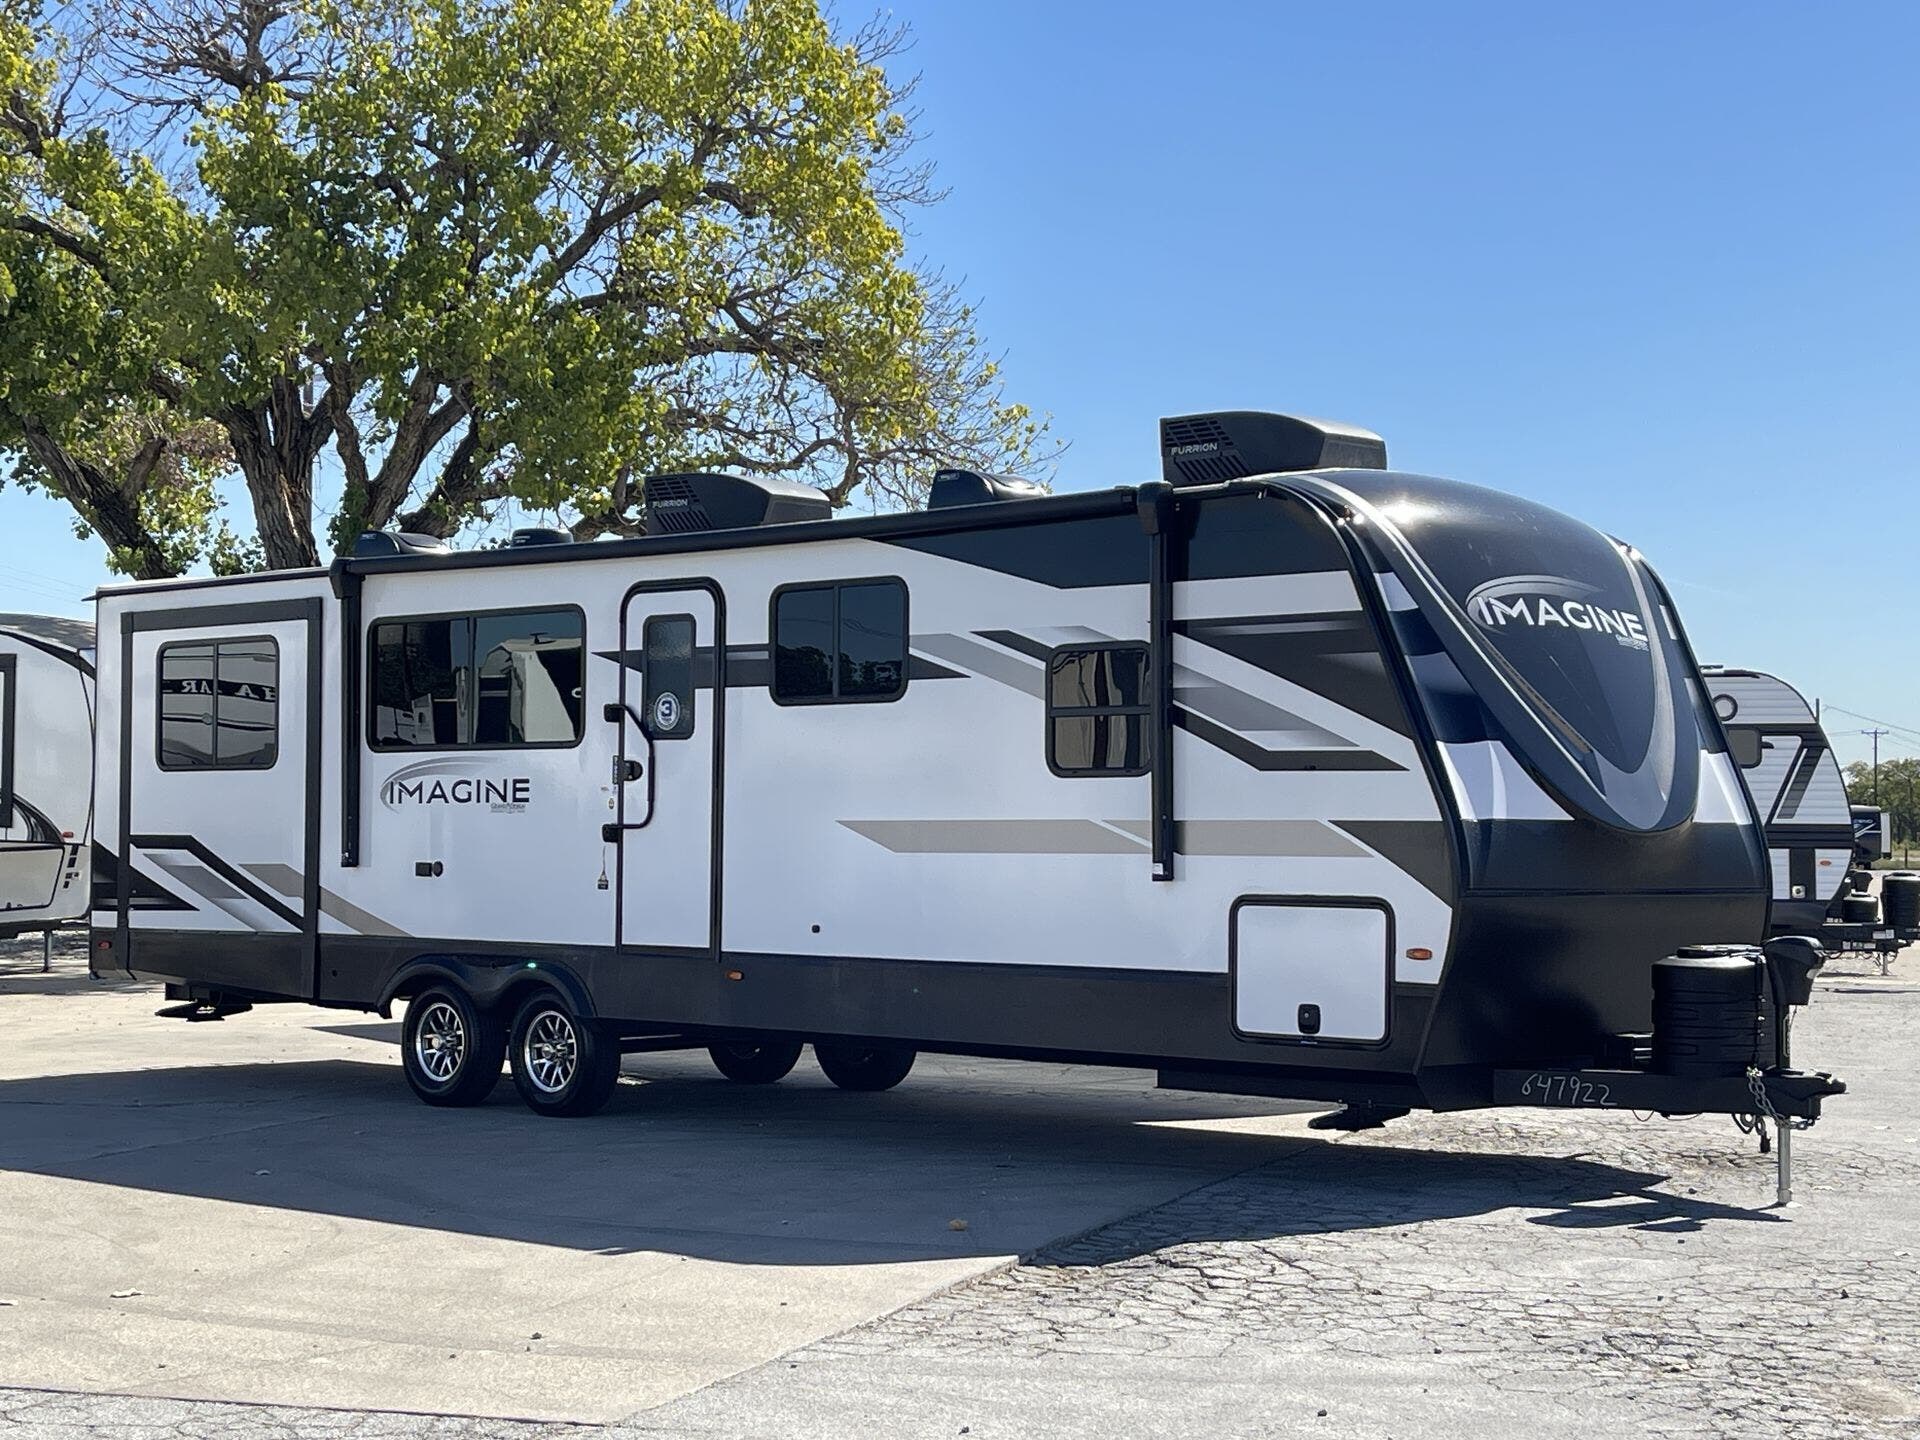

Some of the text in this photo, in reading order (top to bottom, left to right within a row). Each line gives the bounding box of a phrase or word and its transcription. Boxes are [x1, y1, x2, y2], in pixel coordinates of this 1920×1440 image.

[1170, 442, 1218, 456] FURRION
[1475, 596, 1648, 642] IMAGINE
[660, 699, 673, 717] 3
[389, 778, 530, 804] IMAGINE
[1521, 1073, 1618, 1106] 647922
